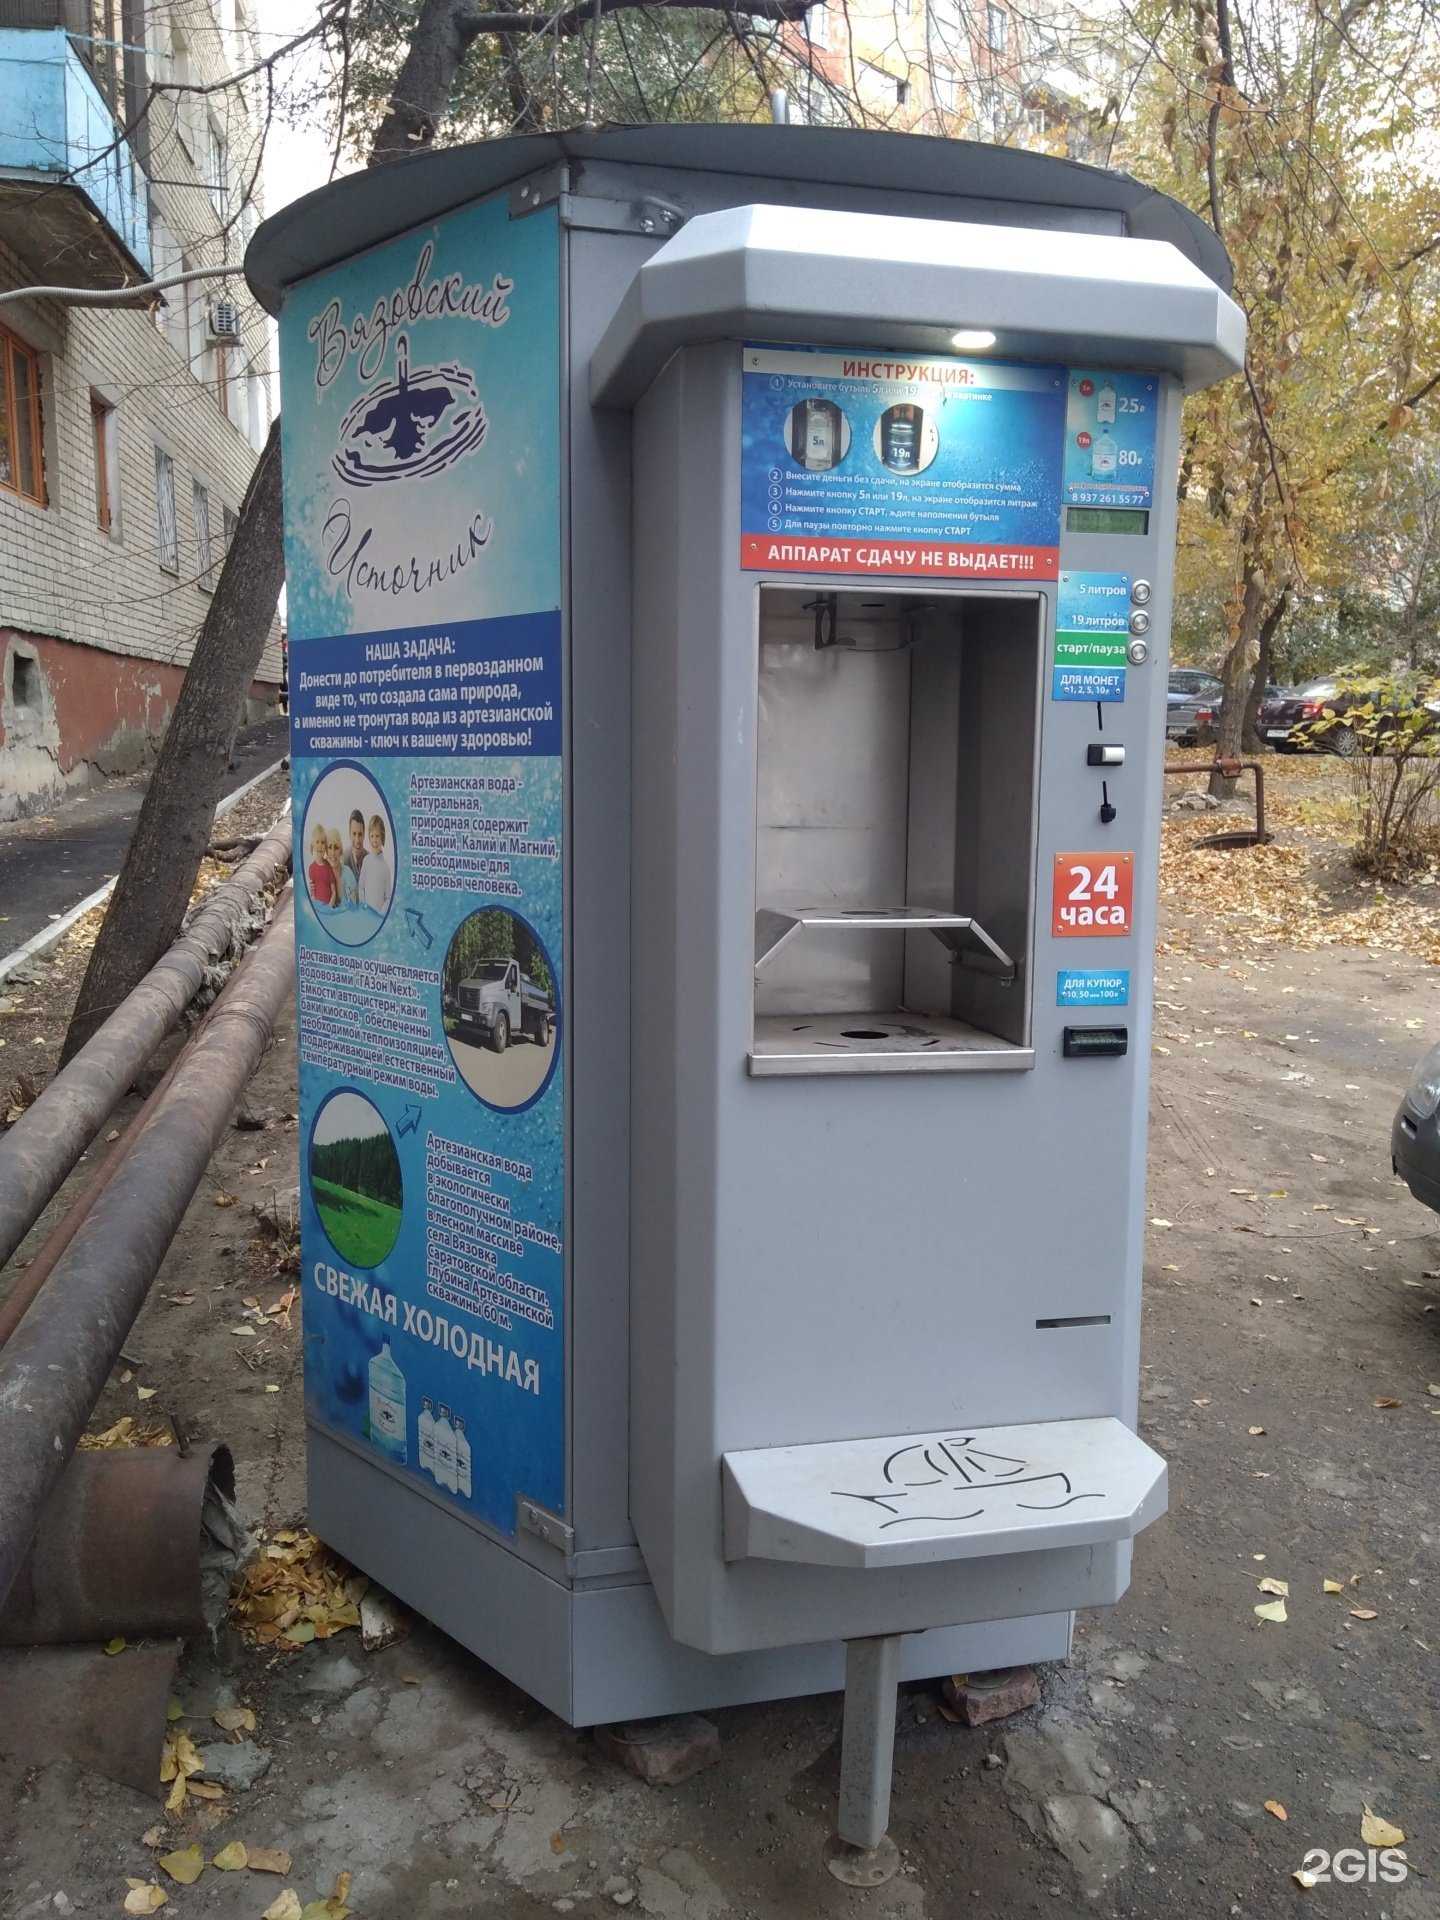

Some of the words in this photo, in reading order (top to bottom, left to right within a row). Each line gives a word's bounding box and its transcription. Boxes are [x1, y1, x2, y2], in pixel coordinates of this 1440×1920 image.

[310, 244, 510, 388] Вязовский
[843, 361, 975, 384] ИНСТРУКЦИЯ:
[787, 380, 837, 392] Установите
[812, 436, 825, 446] 5л
[893, 447, 911, 459] 19л
[785, 470, 821, 481] Внесите
[822, 474, 853, 484] деньги
[854, 473, 869, 484] без
[911, 480, 941, 489] экране
[942, 479, 994, 490] отобразится
[995, 483, 1021, 493] сумма
[785, 487, 825, 497] Нажмите
[826, 491, 857, 500] кнопку
[858, 489, 872, 500] 5л
[872, 492, 889, 500] или
[923, 496, 952, 505] экране
[954, 496, 1006, 507] отобразится
[1007, 500, 1038, 509] литраж
[1072, 492, 1078, 502] 8
[1080, 493, 1097, 502] 937
[1099, 494, 1116, 503] 261
[1119, 494, 1130, 504] 55
[1132, 495, 1144, 504] 77
[785, 503, 825, 514] Нажмите
[826, 507, 857, 516] кнопку
[858, 507, 888, 518] СТАРТ,
[888, 509, 917, 519] ждите
[917, 510, 968, 520] наполнения
[784, 519, 802, 529] Для
[803, 522, 831, 531] паузы
[831, 523, 873, 533] повторно
[874, 525, 912, 534] нажмите
[913, 527, 943, 536] кнопку
[944, 526, 972, 535] СТАРТ
[322, 498, 490, 599] Источник
[767, 545, 852, 562] АППАРАТ
[856, 548, 917, 567] СДАЧУ
[921, 550, 943, 566] НЕ
[948, 552, 1034, 570] ВЫДАЕТ!!!
[1079, 584, 1086, 594] 5
[1088, 585, 1127, 596] литров
[1072, 614, 1084, 625] 19
[1085, 616, 1125, 628] литров
[365, 639, 400, 661] НАША
[403, 636, 456, 659] ЗАДАЧА:
[1056, 643, 1126, 656] старт/пауза
[299, 671, 342, 692] Донести
[344, 673, 357, 689] до
[359, 663, 432, 687] потребителя
[435, 665, 442, 678] в
[445, 656, 544, 683] первозданном
[1060, 675, 1082, 687] ДЛЯ
[1083, 675, 1120, 687] МОНЕТ
[315, 693, 340, 711] виде
[343, 693, 357, 709] то,
[359, 691, 378, 706] что
[380, 687, 426, 706] создала
[428, 686, 458, 702] сама
[460, 682, 522, 705] природа,
[294, 716, 301, 729] а
[302, 714, 341, 729] именно
[343, 713, 356, 728] не
[358, 710, 410, 731] тронутая
[412, 708, 440, 728] вода
[442, 709, 457, 724] из
[459, 702, 553, 728] артезианской
[310, 734, 362, 750] скважины
[370, 733, 400, 750] ключ
[403, 733, 409, 748] к
[411, 731, 458, 752] вашему
[461, 728, 532, 751] здоровью!
[410, 773, 485, 792] Артезианская
[487, 778, 515, 793] вода
[411, 796, 483, 813] натуральная,
[411, 815, 470, 832] природная
[472, 818, 529, 836] содержит
[411, 831, 460, 851] Кальций,
[462, 834, 497, 851] Калий
[499, 841, 507, 852] и
[509, 838, 559, 859] Магний,
[411, 852, 487, 873] необходимые
[488, 860, 510, 875] для
[412, 872, 463, 891] здоровья
[464, 877, 522, 896] человека.
[1067, 865, 1119, 901] 24
[1059, 904, 1126, 926] часа
[300, 946, 338, 966] Доставка
[339, 956, 363, 971] воды
[363, 960, 440, 984] осуществляется
[300, 966, 354, 986] водовозами
[1064, 979, 1086, 990] ДЛЯ
[1087, 978, 1122, 989] КУПЮР
[1079, 990, 1089, 999] 50
[300, 981, 337, 1000] Емкости
[337, 990, 400, 1014] автоцистерн,
[400, 1003, 418, 1018] как
[420, 1008, 428, 1020] и
[301, 997, 321, 1013] баки
[322, 1006, 361, 1025] киосков,
[365, 1011, 432, 1039] обеспеченны
[301, 1015, 361, 1039] необходимой
[362, 1030, 448, 1063] теплоизоляцией,
[302, 1033, 383, 1064] поддерживающей
[384, 1054, 456, 1083] естественный
[303, 1050, 372, 1079] температурный
[373, 1068, 407, 1089] режим
[408, 1078, 439, 1098] воды.
[427, 1133, 501, 1170] Артезианская
[504, 1162, 533, 1181] вода
[427, 1155, 491, 1185] добывается
[427, 1172, 433, 1184] в
[434, 1175, 510, 1212] экологически
[427, 1188, 512, 1232] благополучном
[514, 1219, 562, 1253] районе,
[427, 1209, 433, 1221] в
[434, 1213, 475, 1236] лесном
[476, 1229, 524, 1256] массиве
[427, 1227, 451, 1246] села
[451, 1233, 497, 1265] Вязовка
[427, 1244, 496, 1284] Саратовской
[497, 1273, 549, 1307] области.
[427, 1261, 471, 1291] Глубина
[471, 1280, 553, 1328] Артезианской
[427, 1282, 483, 1316] скважины
[483, 1303, 497, 1324] 60
[498, 1312, 513, 1331] м.
[313, 1262, 397, 1326] СВЕЖАЯ
[402, 1301, 540, 1396] ХОЛОДНАЯ
